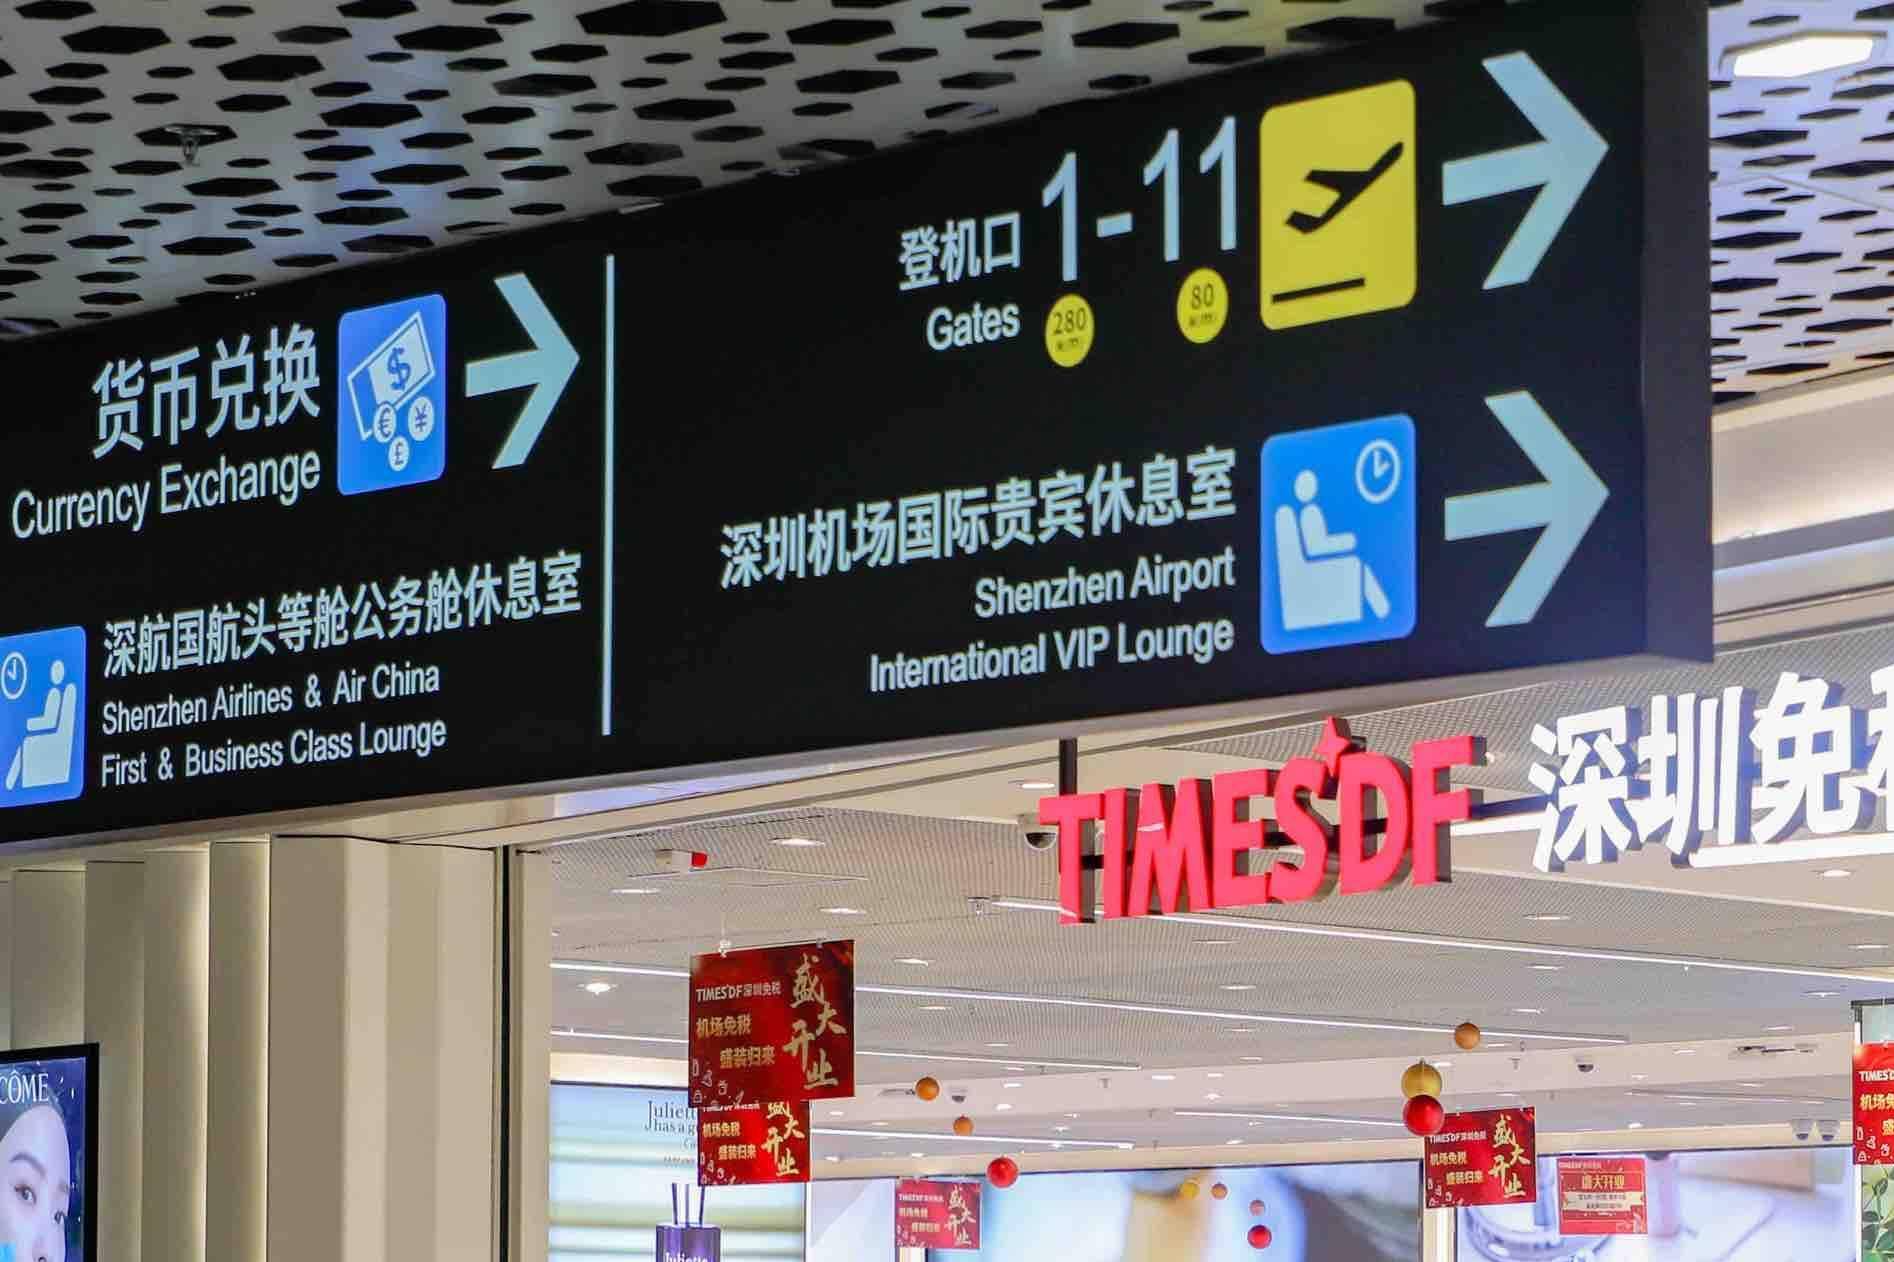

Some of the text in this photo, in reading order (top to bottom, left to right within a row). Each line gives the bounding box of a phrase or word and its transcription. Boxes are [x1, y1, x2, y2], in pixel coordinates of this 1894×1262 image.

[899, 115, 1238, 291] 登机口 1-11
[927, 304, 1019, 352] Gates
[1054, 307, 1088, 335] 280
[1192, 283, 1215, 311] 80
[93, 323, 320, 459] 货币兑换
[12, 449, 321, 540] Currency Exchange
[720, 445, 1236, 590] 深圳机场国际贵宾休息室
[103, 549, 583, 679] 深航国航头等舱公务舱休息室
[975, 545, 1235, 620] Shenzhen Airport
[870, 613, 1234, 693] International VIP Lounge
[103, 660, 441, 733] Shenzhen Airlines & Air China
[102, 715, 447, 788] First & Business Class Lounge
[696, 1013, 751, 1038] 机场免税
[0, 1071, 49, 1103] CÔME
[645, 1100, 697, 1127] Juliett
